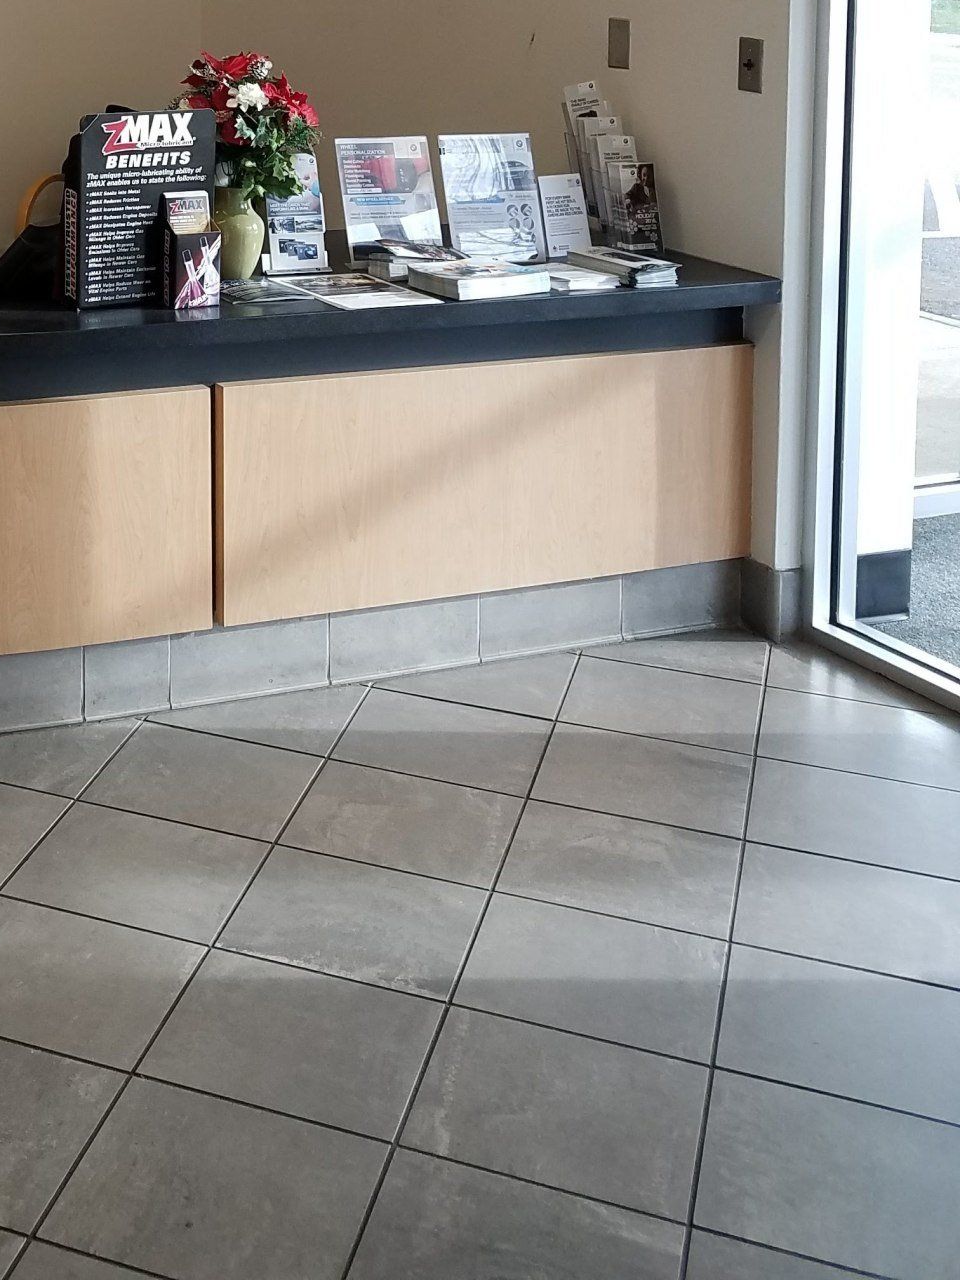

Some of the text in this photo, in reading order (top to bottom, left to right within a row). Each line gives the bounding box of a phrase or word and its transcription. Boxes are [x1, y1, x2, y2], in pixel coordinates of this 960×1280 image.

[105, 151, 192, 169] BENEFITS
[100, 172, 121, 181] unique
[122, 168, 174, 179] micro-lubricating
[175, 166, 194, 176] ability
[195, 166, 202, 174] of
[107, 178, 131, 187] enables
[140, 177, 147, 185] to
[148, 176, 164, 184] state
[165, 175, 176, 183] the
[176, 174, 207, 183] following:
